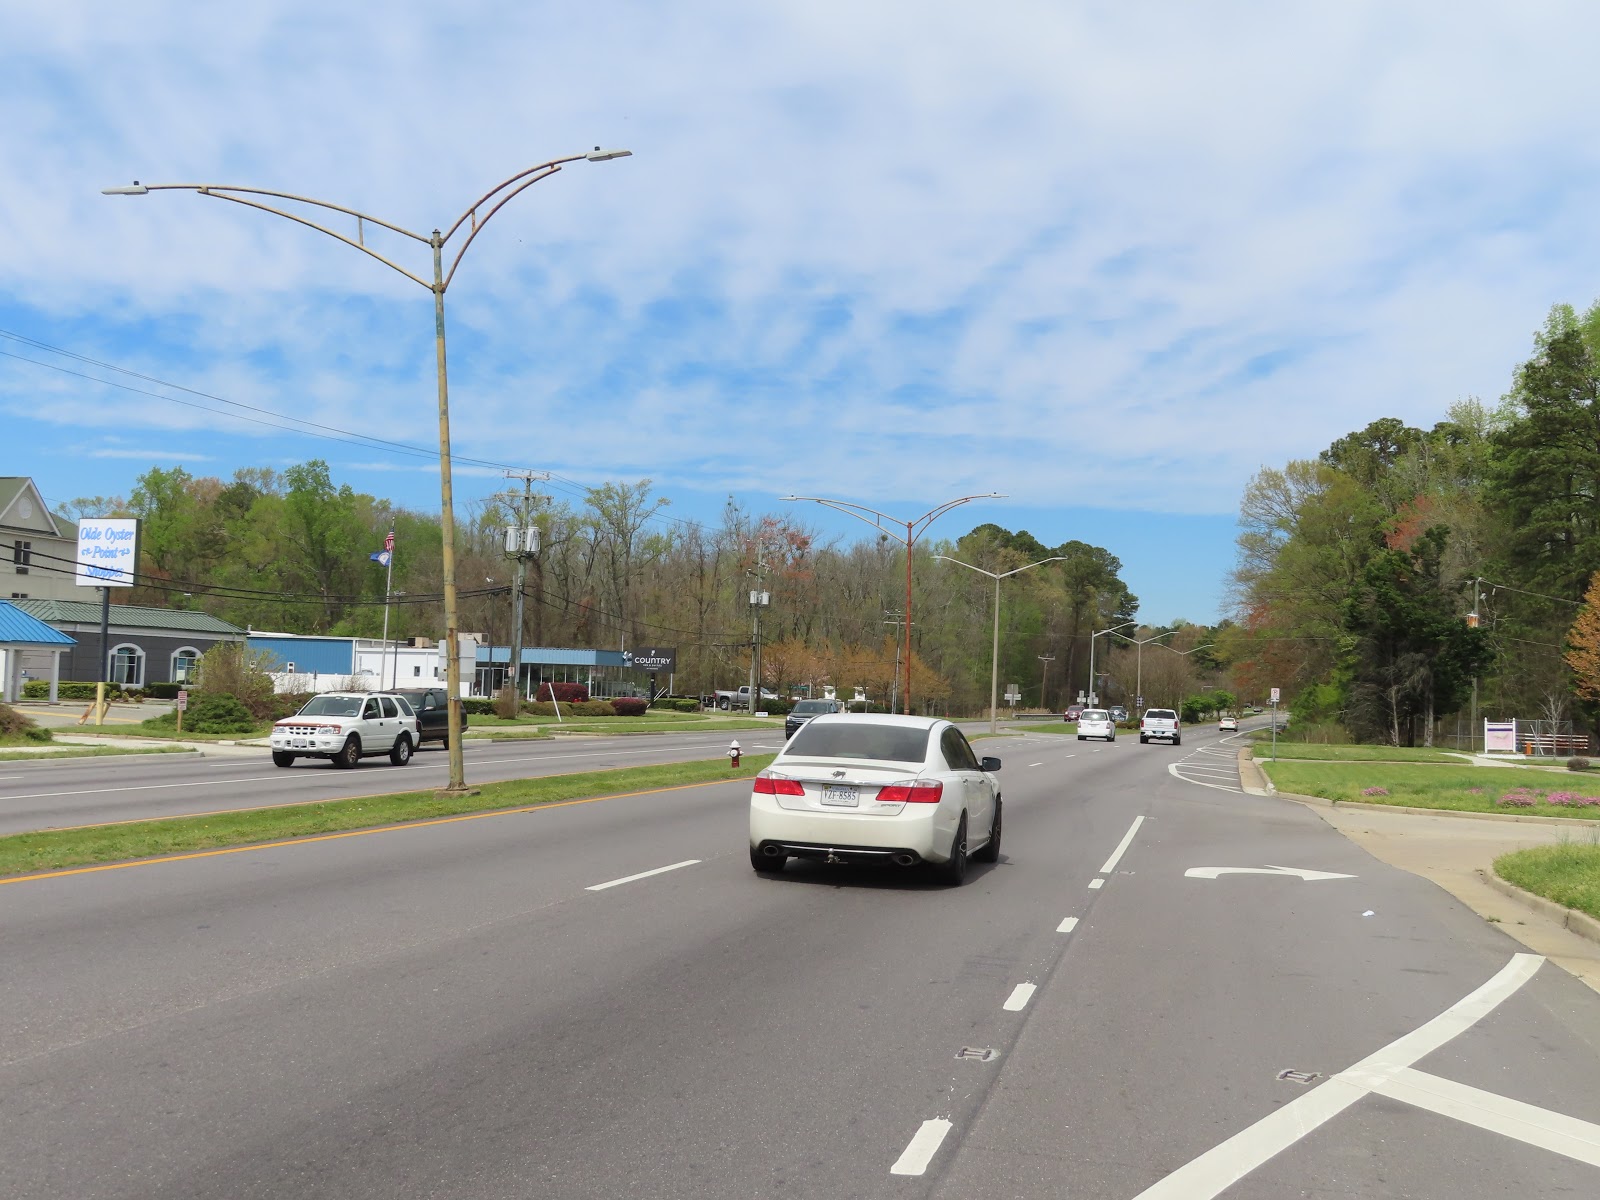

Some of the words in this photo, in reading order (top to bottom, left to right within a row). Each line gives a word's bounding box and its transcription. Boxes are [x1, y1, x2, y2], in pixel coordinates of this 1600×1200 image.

[80, 527, 102, 540] Olde
[105, 527, 134, 544] Oyster
[92, 546, 118, 558] Point
